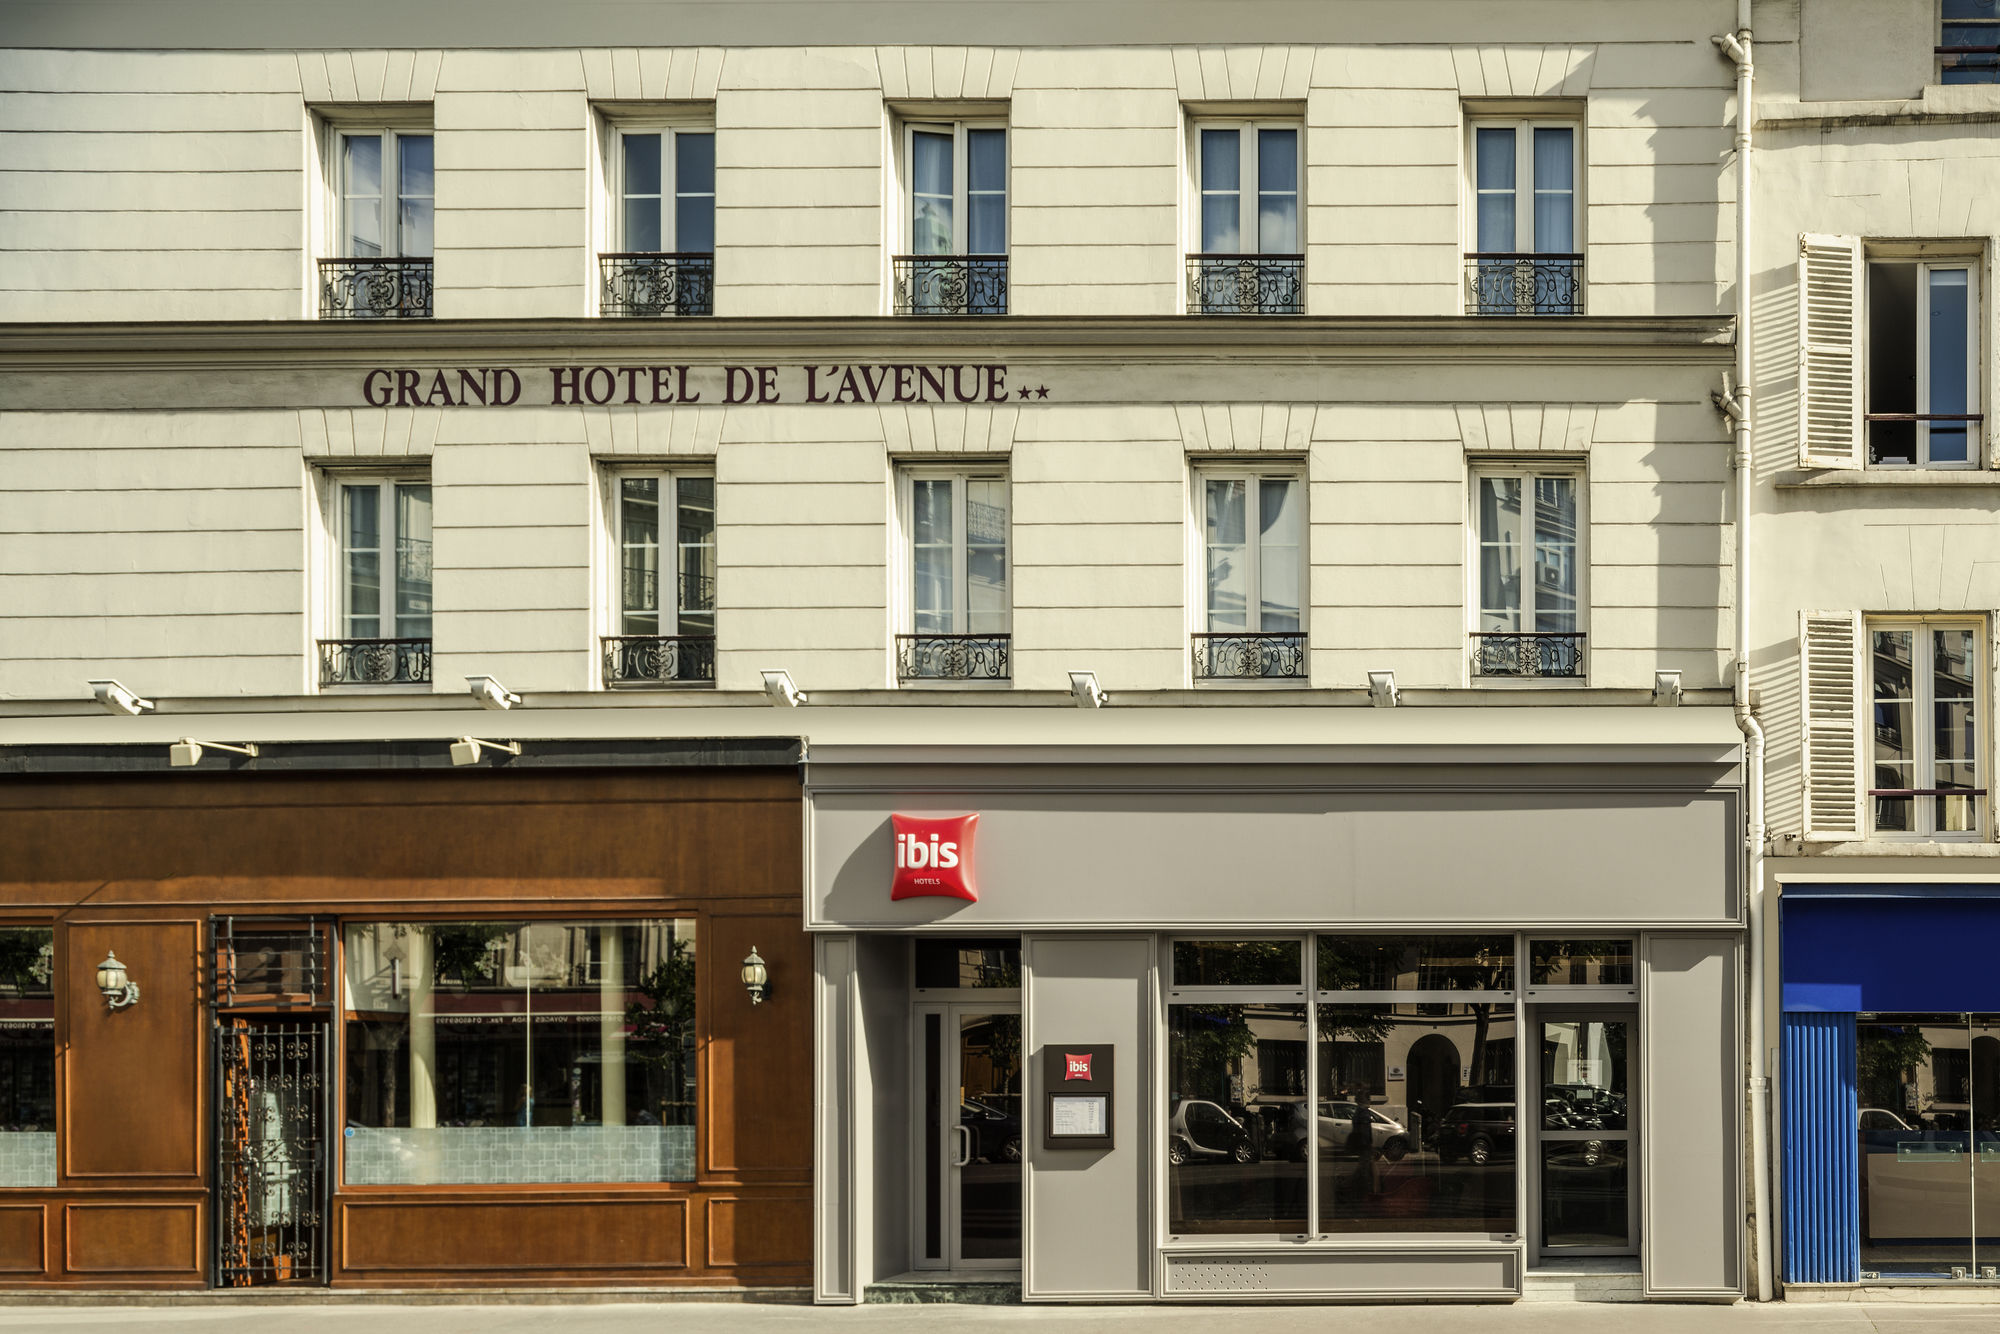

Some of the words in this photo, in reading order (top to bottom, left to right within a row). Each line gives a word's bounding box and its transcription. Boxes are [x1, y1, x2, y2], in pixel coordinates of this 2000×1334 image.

[364, 369, 521, 408] GRAND
[551, 367, 701, 406] HOTEL
[722, 367, 781, 404] DE
[807, 365, 1009, 404] L'AVENUE
[898, 834, 958, 868] ibis
[914, 878, 940, 886] HOTELS
[1069, 1061, 1088, 1072] ibis
